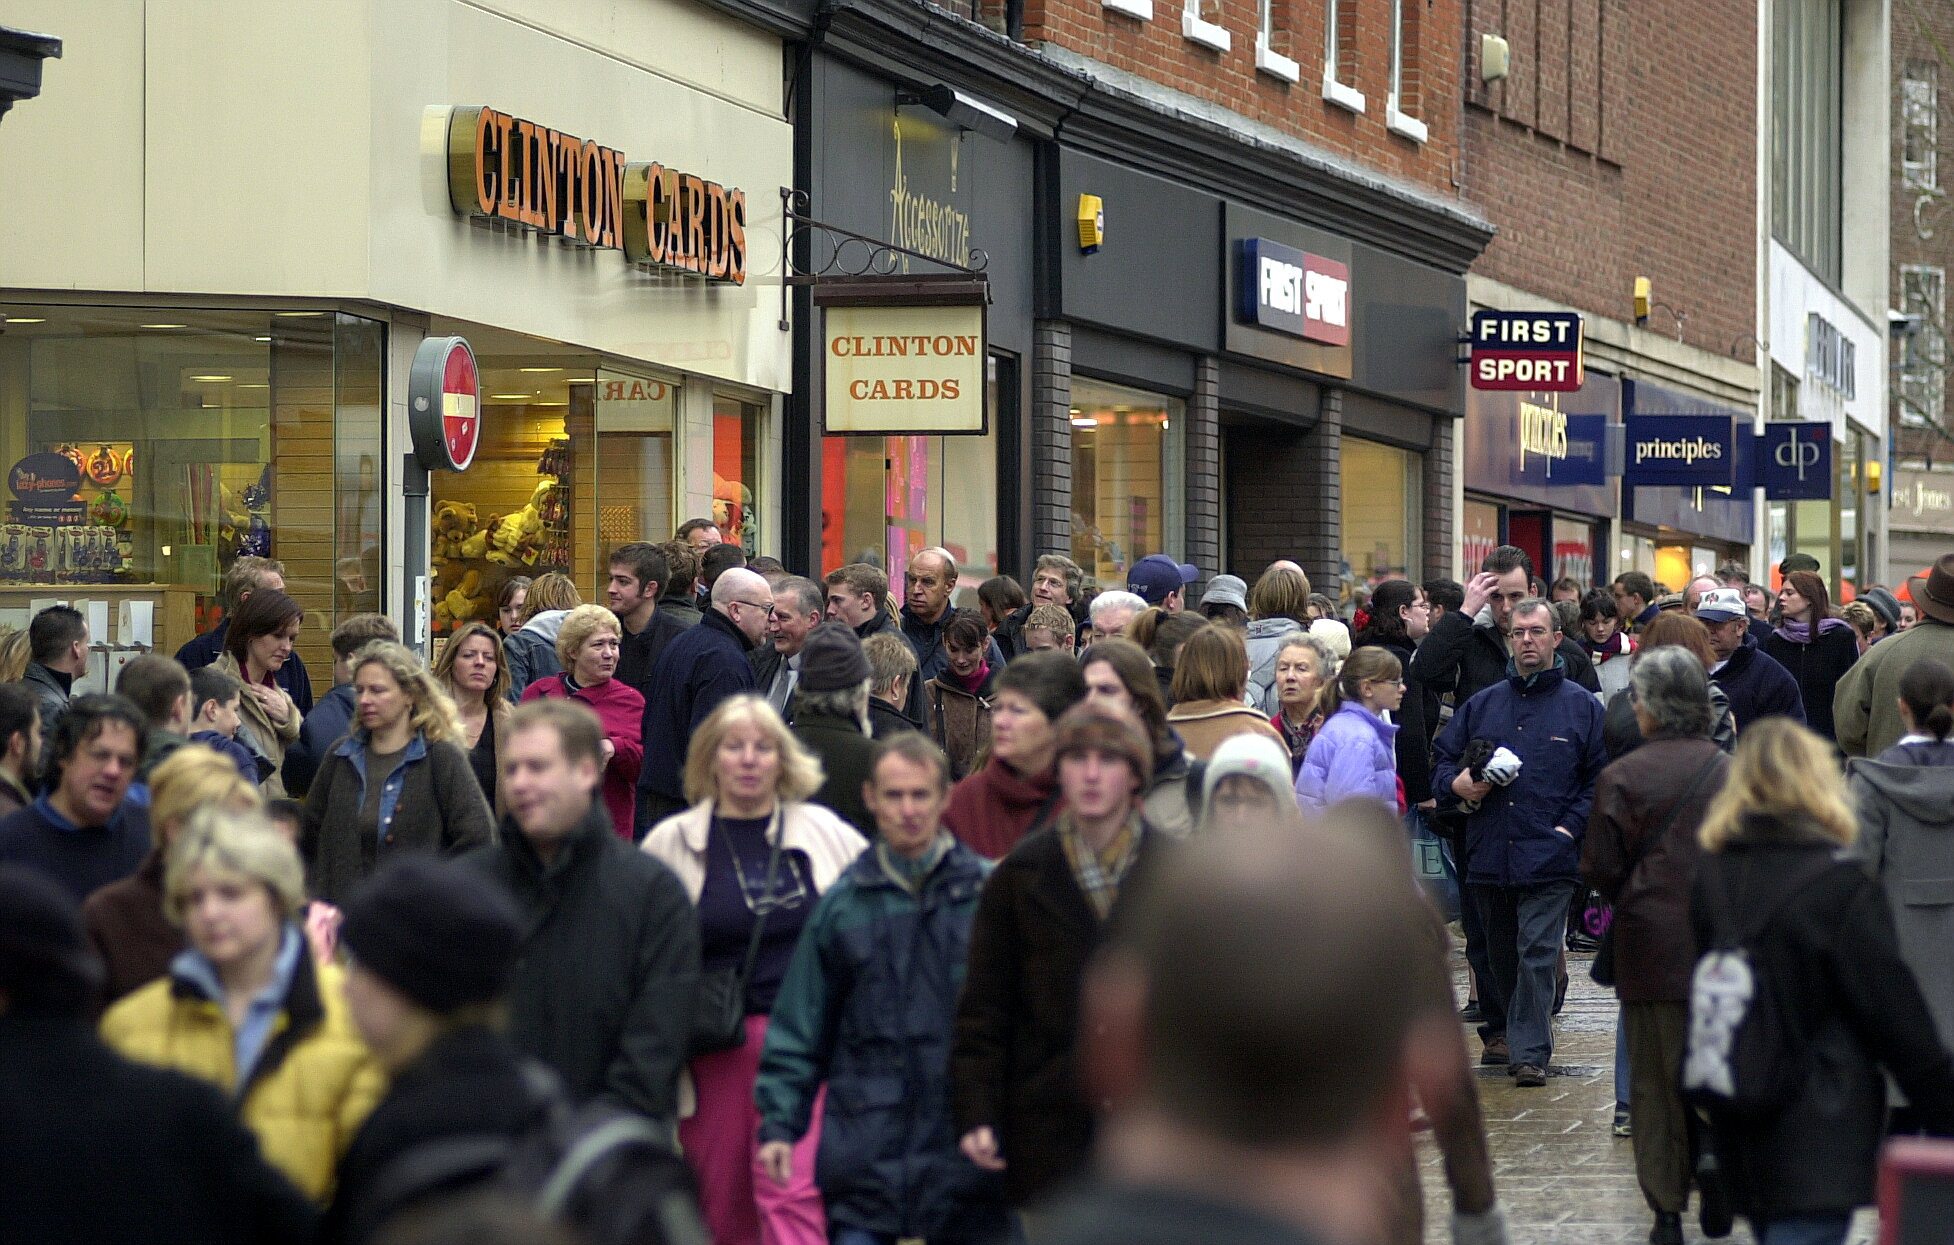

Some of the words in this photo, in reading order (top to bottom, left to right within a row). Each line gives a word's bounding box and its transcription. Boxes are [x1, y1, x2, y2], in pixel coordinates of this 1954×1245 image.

[475, 105, 626, 250] CLINTON
[647, 160, 747, 286] CARDS
[889, 121, 970, 275] Accessorize
[1480, 319, 1571, 343] FIRST
[831, 335, 979, 357] CLINTON
[1479, 358, 1570, 383] SPORT
[849, 379, 960, 401] CARDS
[1636, 436, 1722, 465] principles
[1775, 427, 1821, 481] dp
